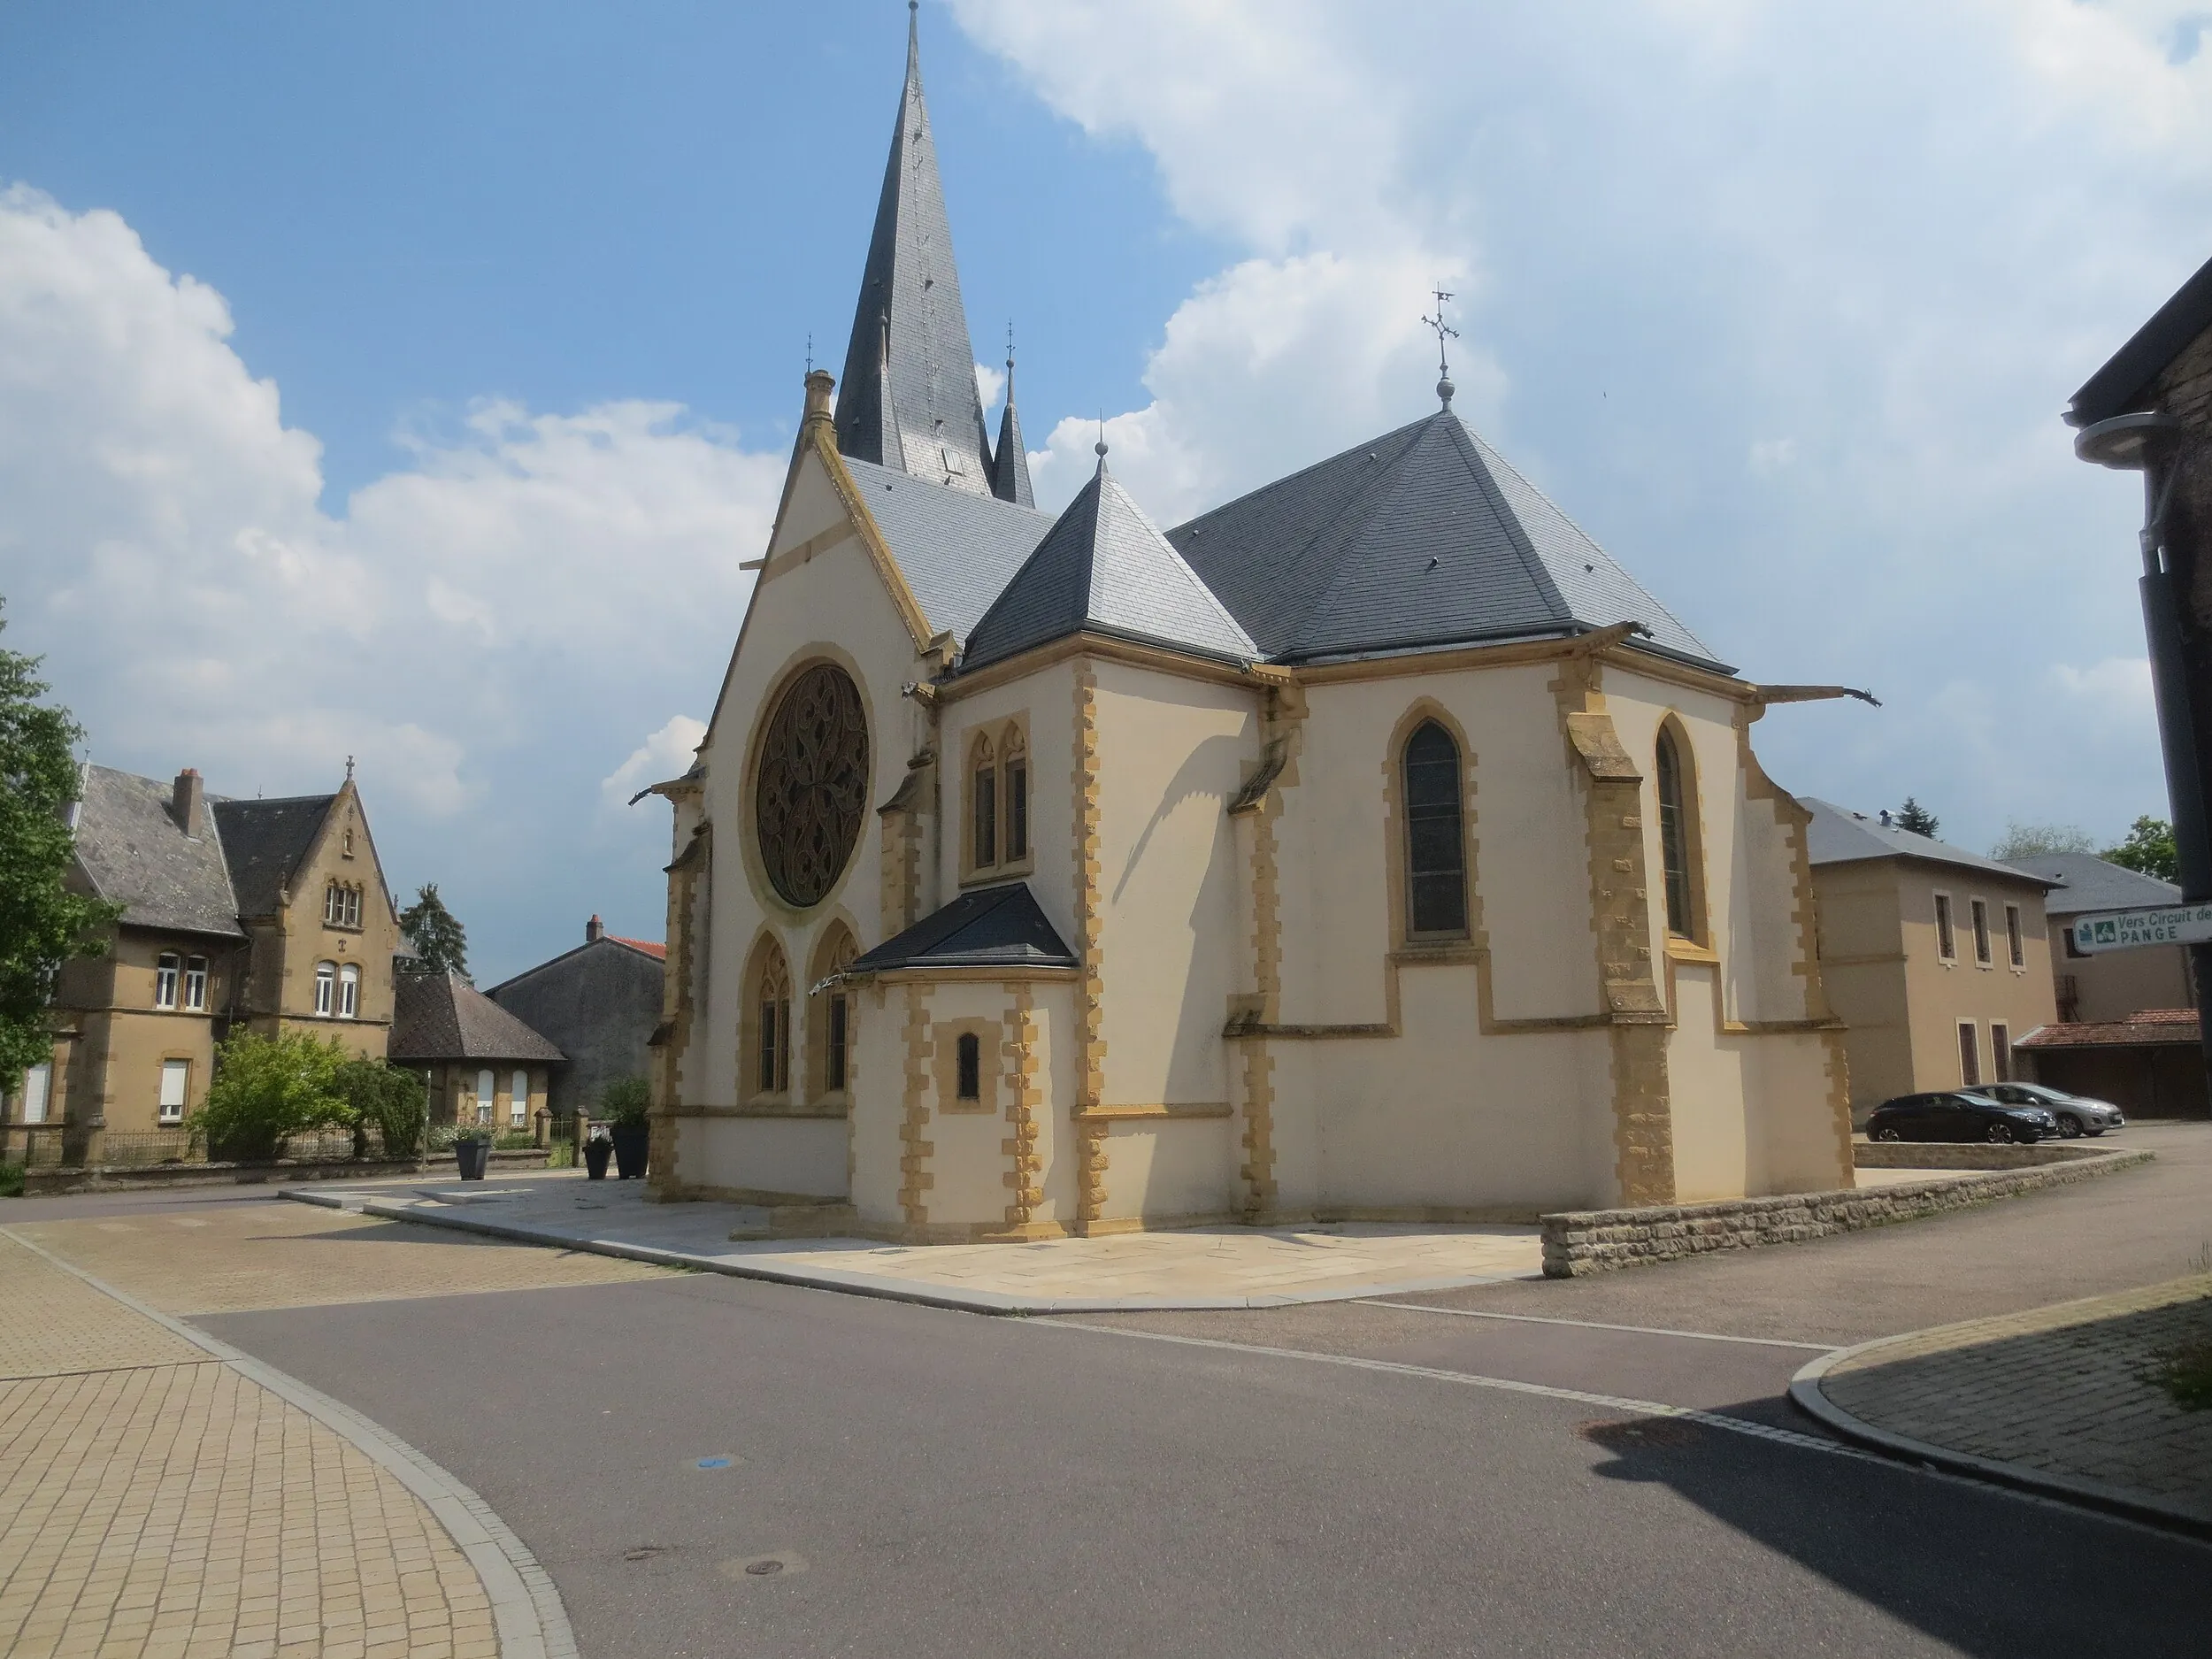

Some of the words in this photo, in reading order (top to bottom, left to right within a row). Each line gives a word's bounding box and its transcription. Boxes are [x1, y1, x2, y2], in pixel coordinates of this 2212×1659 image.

[2117, 916, 2145, 929] Vers
[2149, 910, 2192, 926] Circuit
[2120, 926, 2177, 944] PANGE
